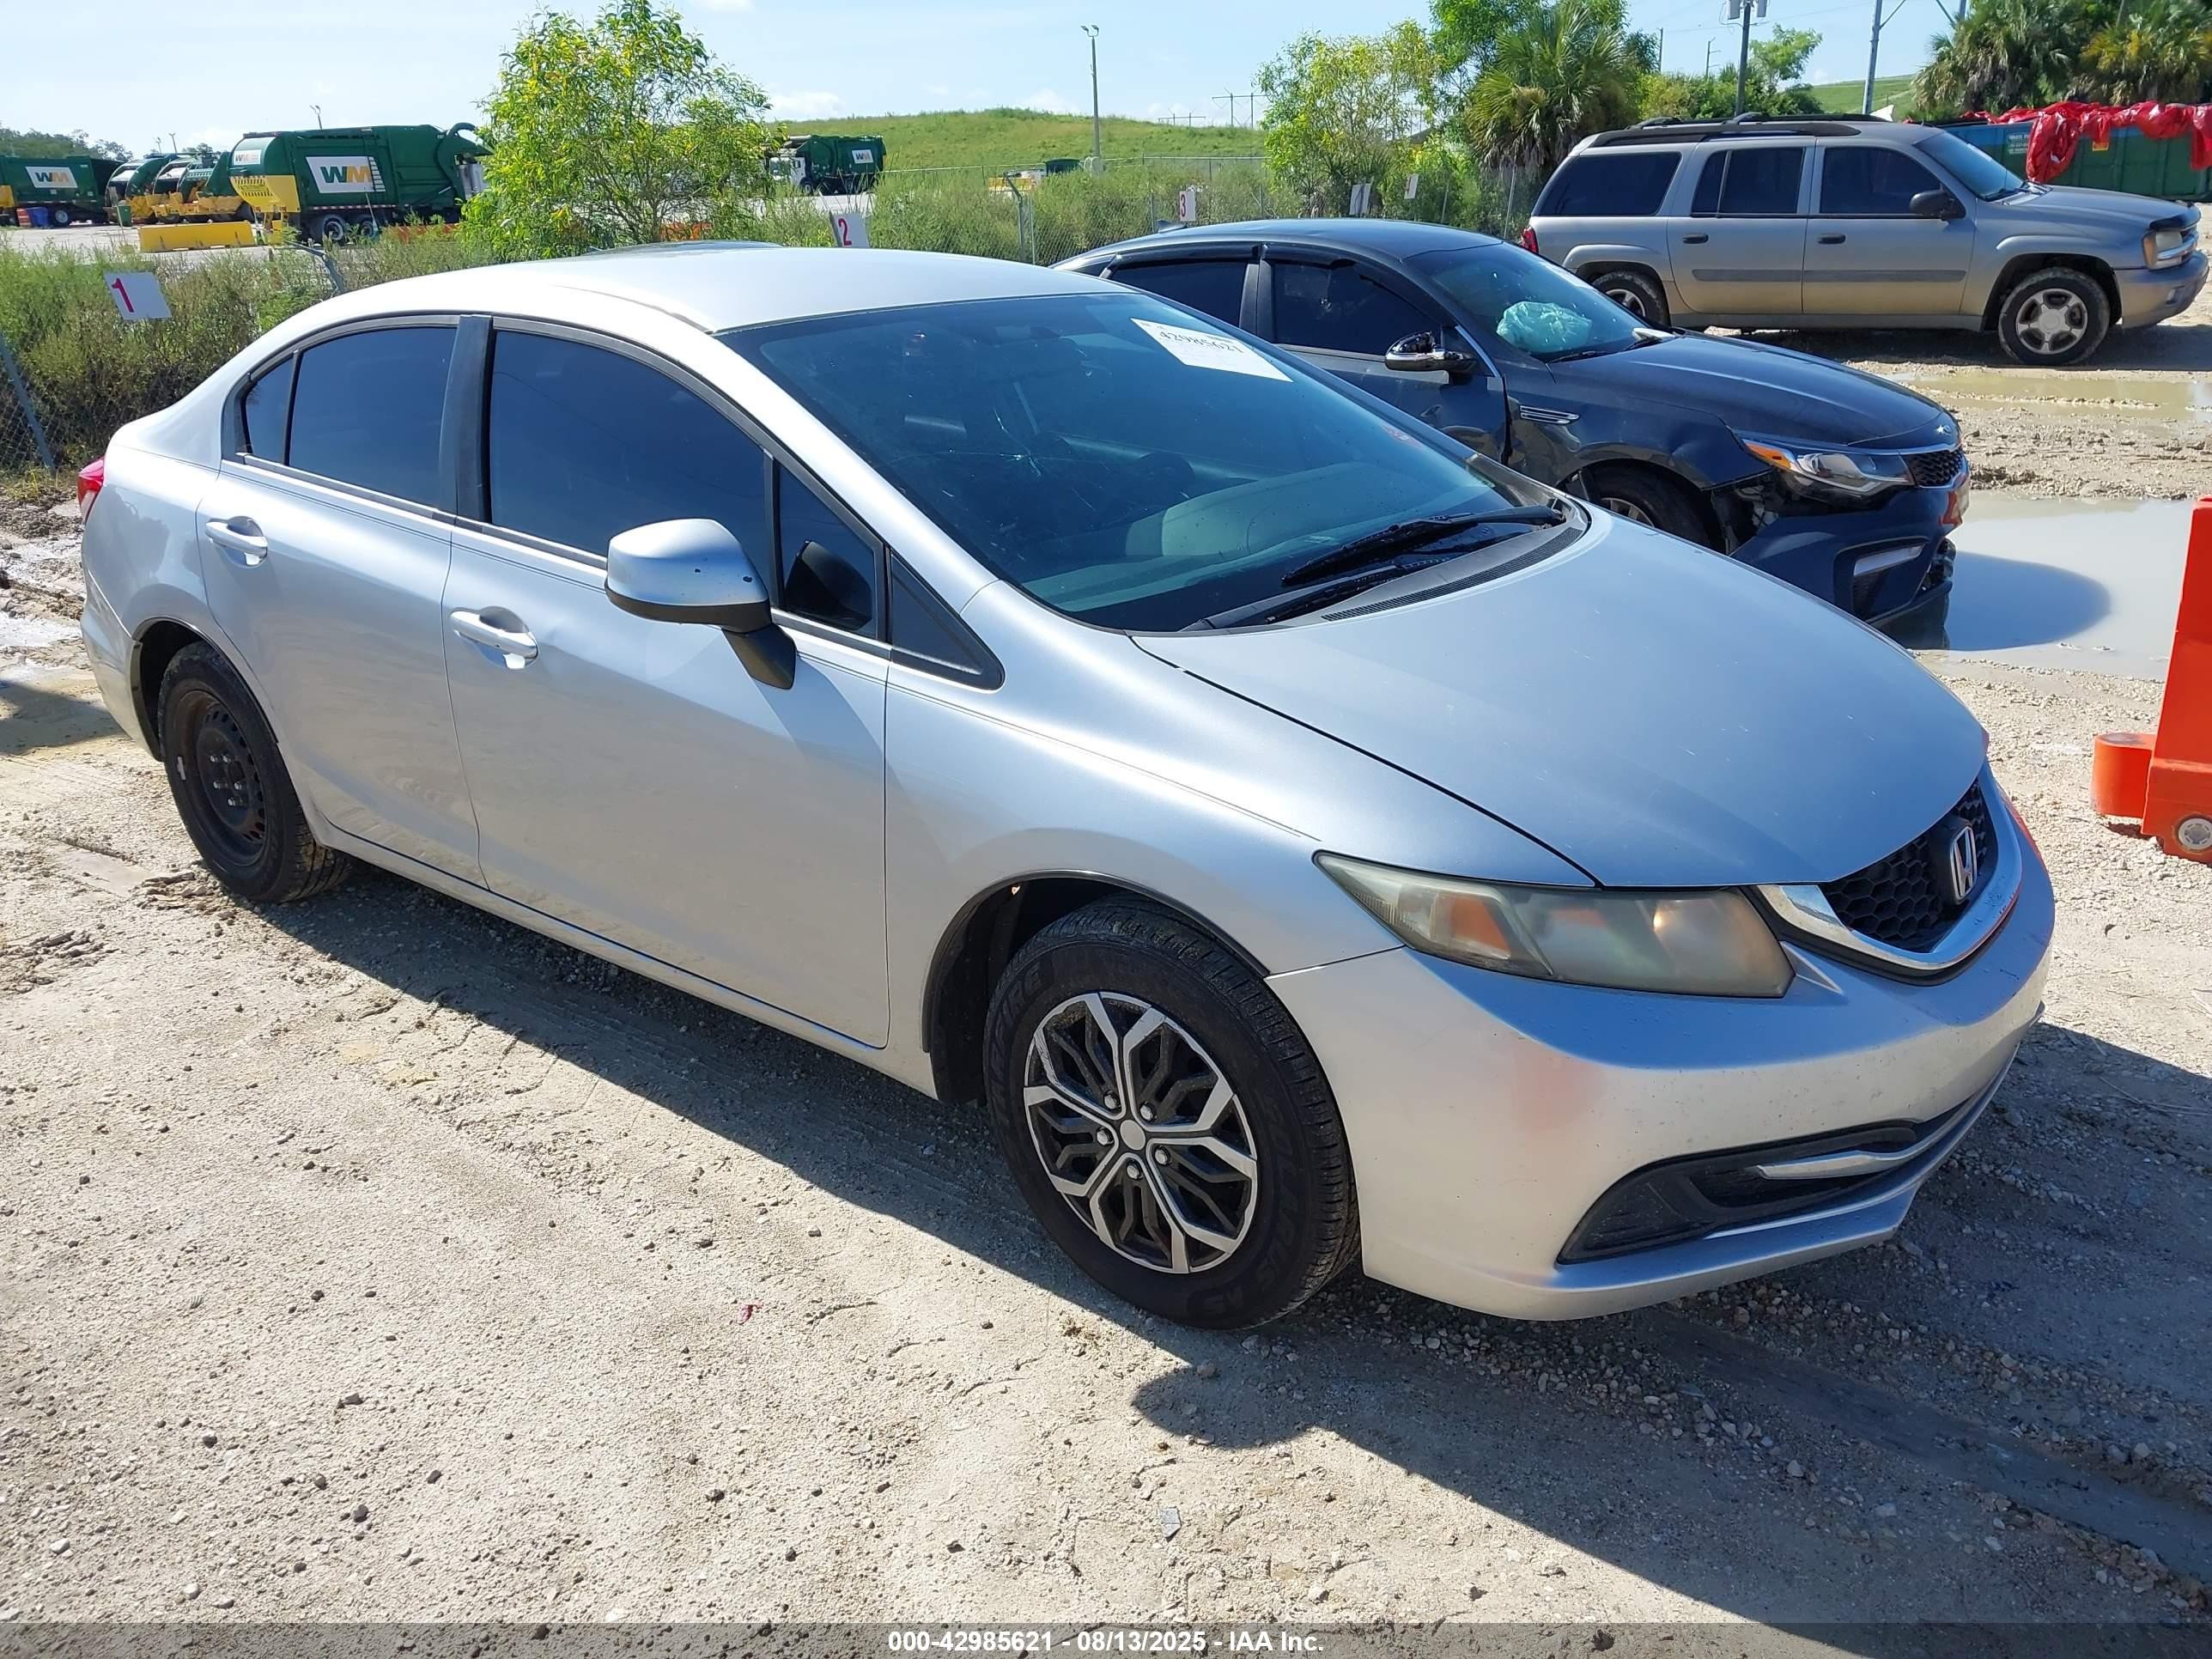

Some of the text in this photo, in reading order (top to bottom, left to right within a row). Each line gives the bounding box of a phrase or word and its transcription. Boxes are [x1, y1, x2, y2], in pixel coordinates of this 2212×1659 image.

[34, 172, 70, 182] WM
[320, 166, 373, 183] WM
[1181, 194, 1186, 217] 3
[838, 218, 852, 246] 2
[112, 277, 135, 313] 1
